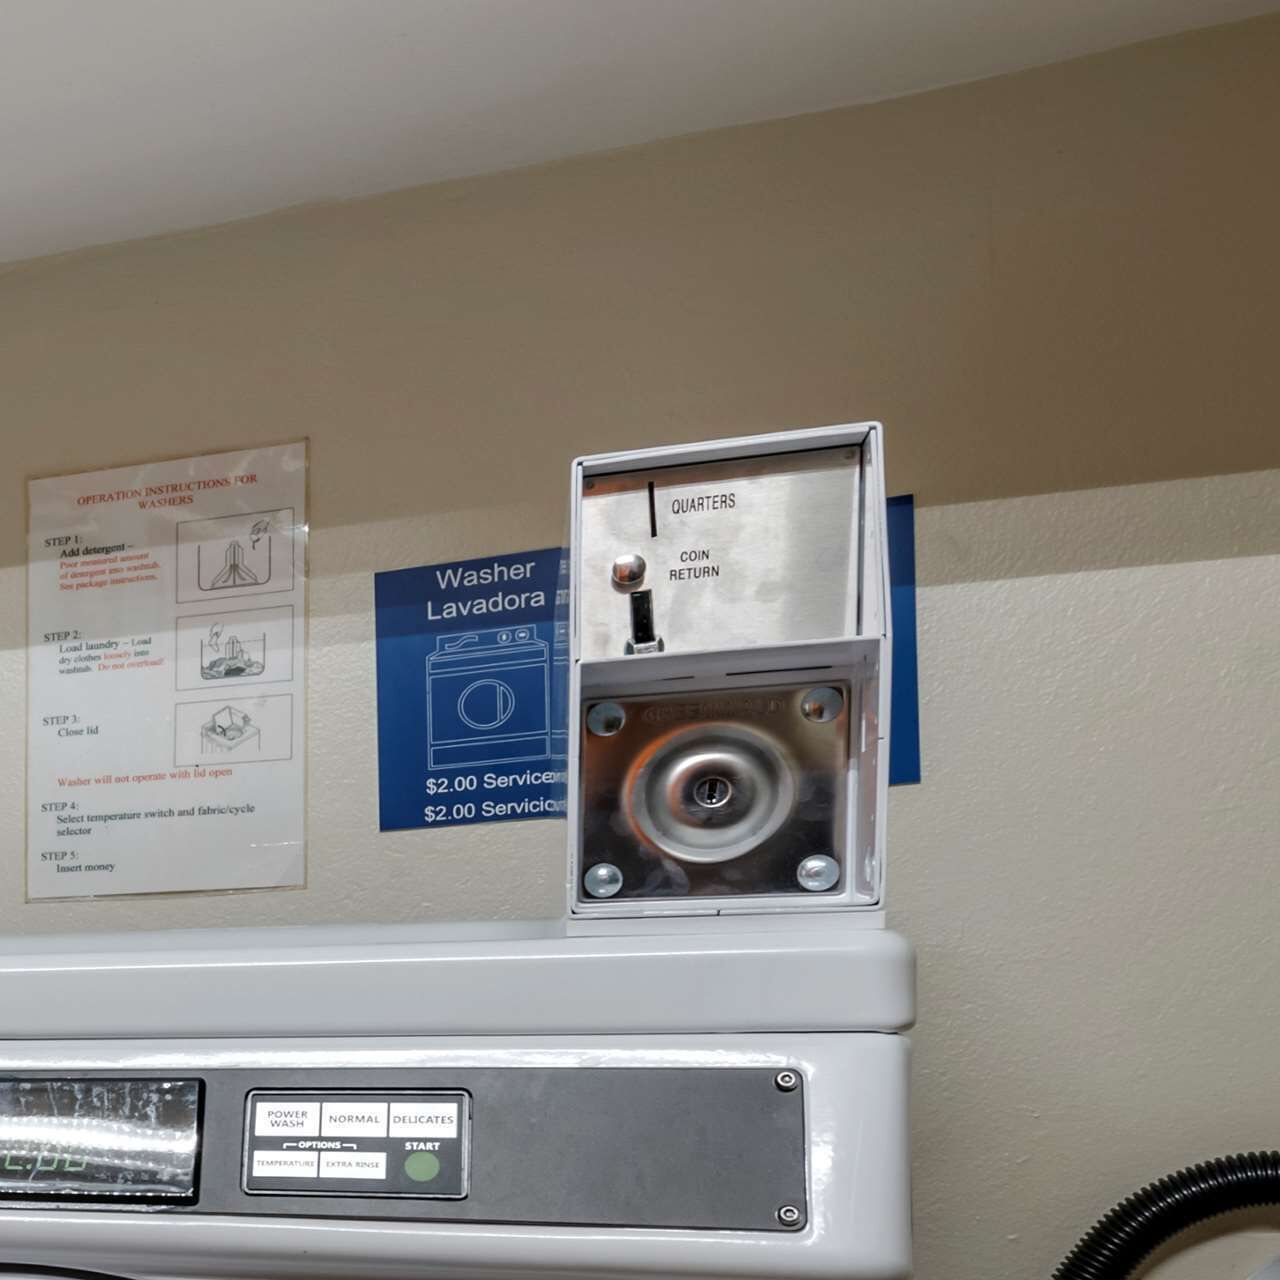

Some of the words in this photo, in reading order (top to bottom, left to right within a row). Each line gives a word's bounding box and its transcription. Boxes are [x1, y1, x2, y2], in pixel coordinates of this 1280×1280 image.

[77, 489, 142, 505] OPERATION
[145, 478, 230, 497] INSTRUCTIONS
[138, 495, 194, 509] WASHERS
[671, 493, 736, 515] QUARTERS
[44, 536, 71, 548] STEP
[60, 548, 80, 559] Add
[82, 544, 125, 556] detergent
[679, 549, 710, 563] COIN
[435, 560, 537, 590] Washer
[669, 565, 720, 582] RETURN
[427, 590, 546, 621] Lavadora
[44, 631, 71, 642] STEP
[60, 642, 82, 653] Load
[86, 640, 119, 652] laundry
[131, 636, 152, 646] Load
[58, 655, 71, 666] dry
[74, 653, 101, 663] clothes
[43, 715, 70, 727] STEP
[58, 727, 85, 738] Close
[87, 725, 99, 736] lid
[57, 777, 91, 788] Washer
[94, 775, 113, 786] will
[114, 775, 130, 784] not
[132, 773, 167, 785] operate
[169, 769, 190, 780] with
[194, 768, 206, 778] lid
[209, 768, 233, 779] open
[425, 774, 478, 795] $2.00
[483, 769, 554, 789] Service
[41, 802, 68, 813] STEP
[56, 814, 85, 825] Select
[87, 811, 141, 824] temperature
[144, 808, 175, 819] switch
[177, 806, 195, 816] and
[198, 803, 256, 816] fabric/cycle
[424, 802, 476, 823] $2.00
[56, 826, 92, 837] selector
[41, 851, 68, 862] STEP
[56, 863, 82, 874] Insert
[84, 861, 115, 873] money
[267, 1110, 309, 1119] POWER
[329, 1114, 381, 1124] NORMAL
[393, 1115, 455, 1125] DELICATES
[270, 1119, 305, 1129] WASH
[298, 1141, 341, 1150] OPTIONS
[405, 1142, 441, 1151] START
[256, 1160, 315, 1168] TEMPERATURE
[326, 1160, 353, 1169] EXTRA
